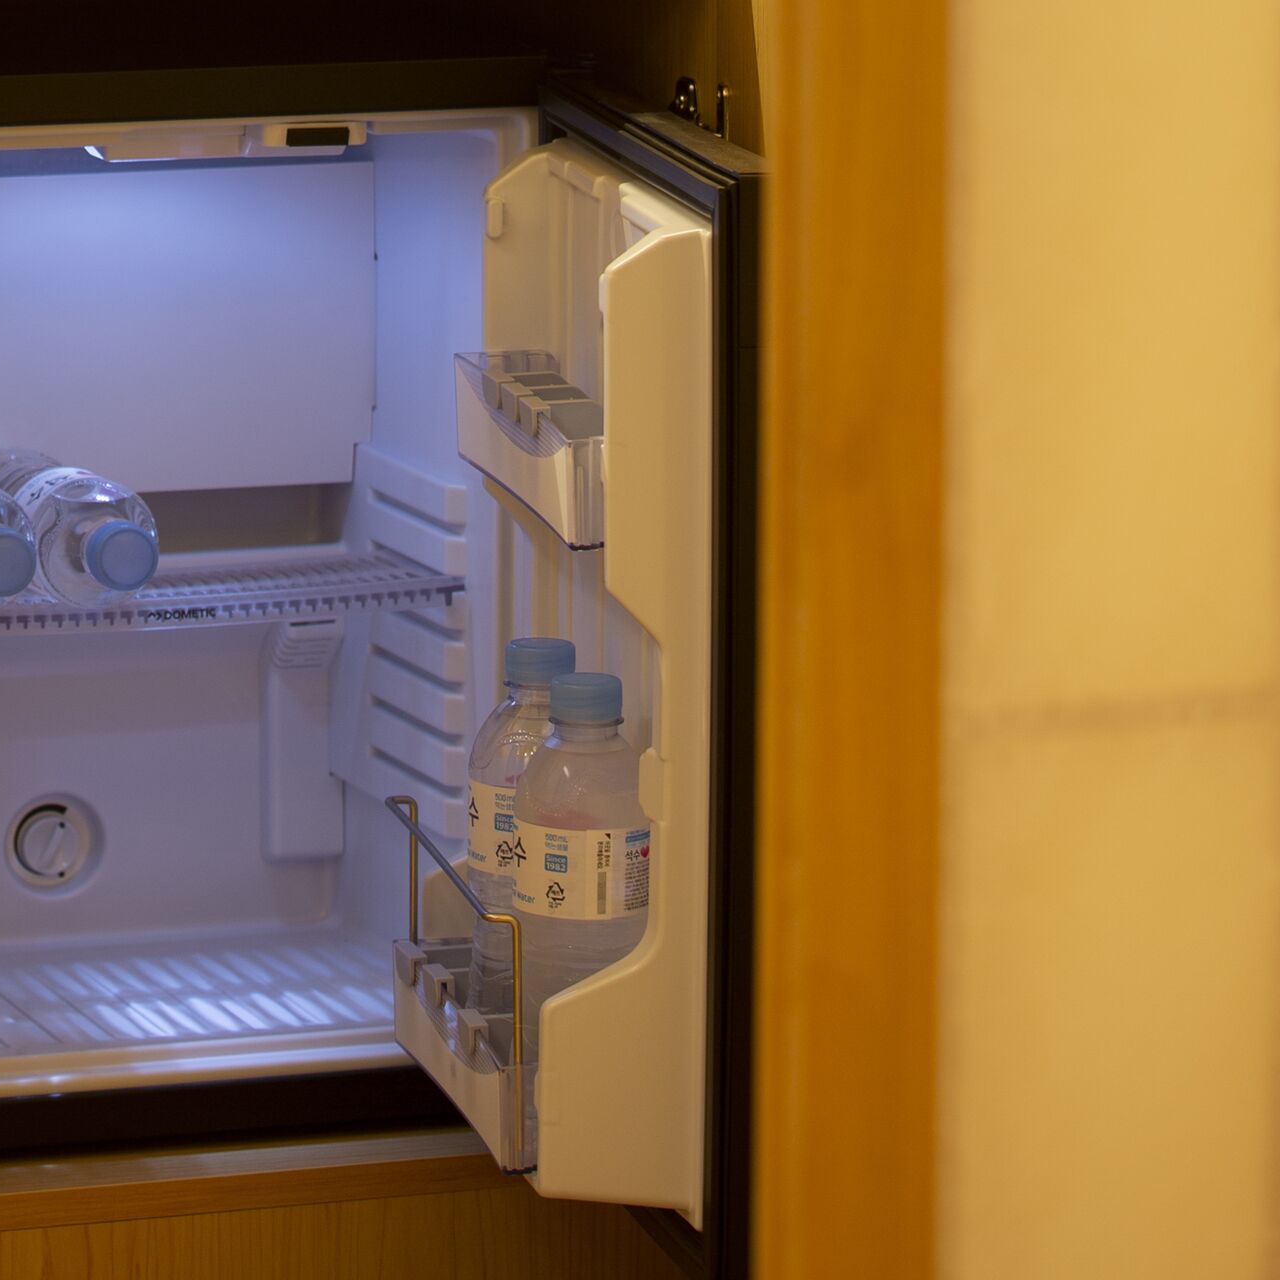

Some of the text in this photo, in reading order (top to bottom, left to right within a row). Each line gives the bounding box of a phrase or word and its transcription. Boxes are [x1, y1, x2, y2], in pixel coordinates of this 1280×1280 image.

[164, 607, 216, 620] DOMETIC
[469, 796, 479, 828] 수
[496, 822, 513, 831] 1982
[513, 836, 527, 868] 수
[546, 854, 567, 863] Since
[624, 849, 640, 862] 석수
[546, 862, 567, 872] 1982
